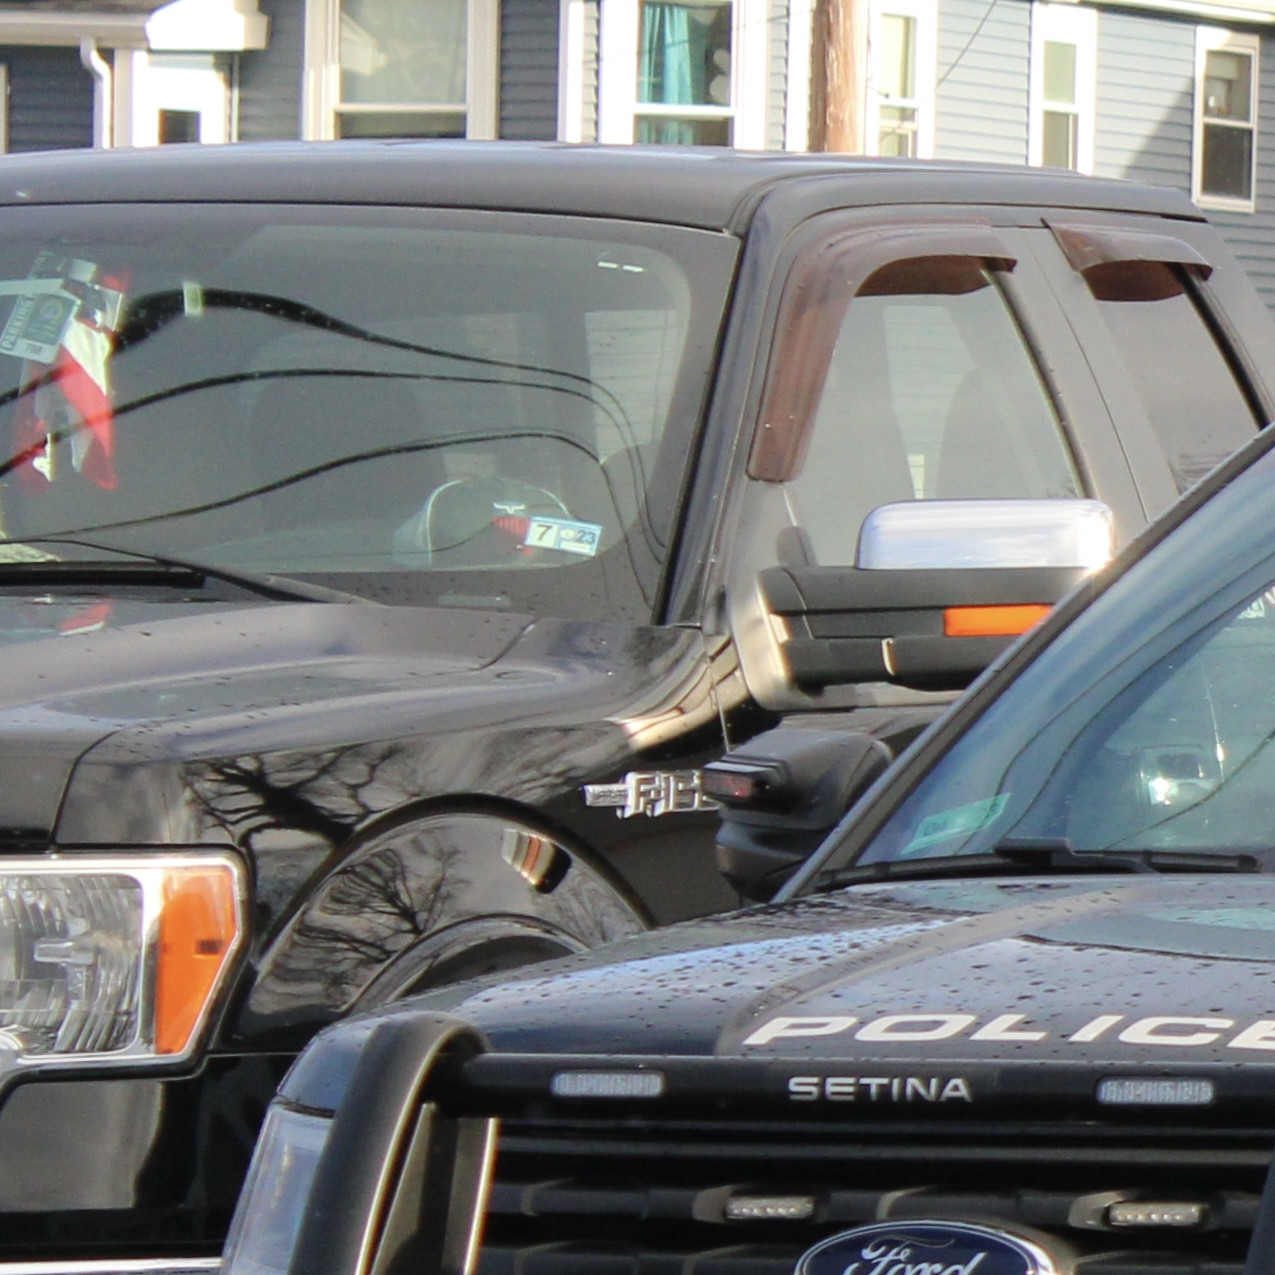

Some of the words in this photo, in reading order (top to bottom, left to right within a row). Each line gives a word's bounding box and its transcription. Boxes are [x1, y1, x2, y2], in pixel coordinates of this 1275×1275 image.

[536, 523, 553, 542] 7
[576, 529, 597, 545] 23
[788, 1076, 972, 1102] SETINA
